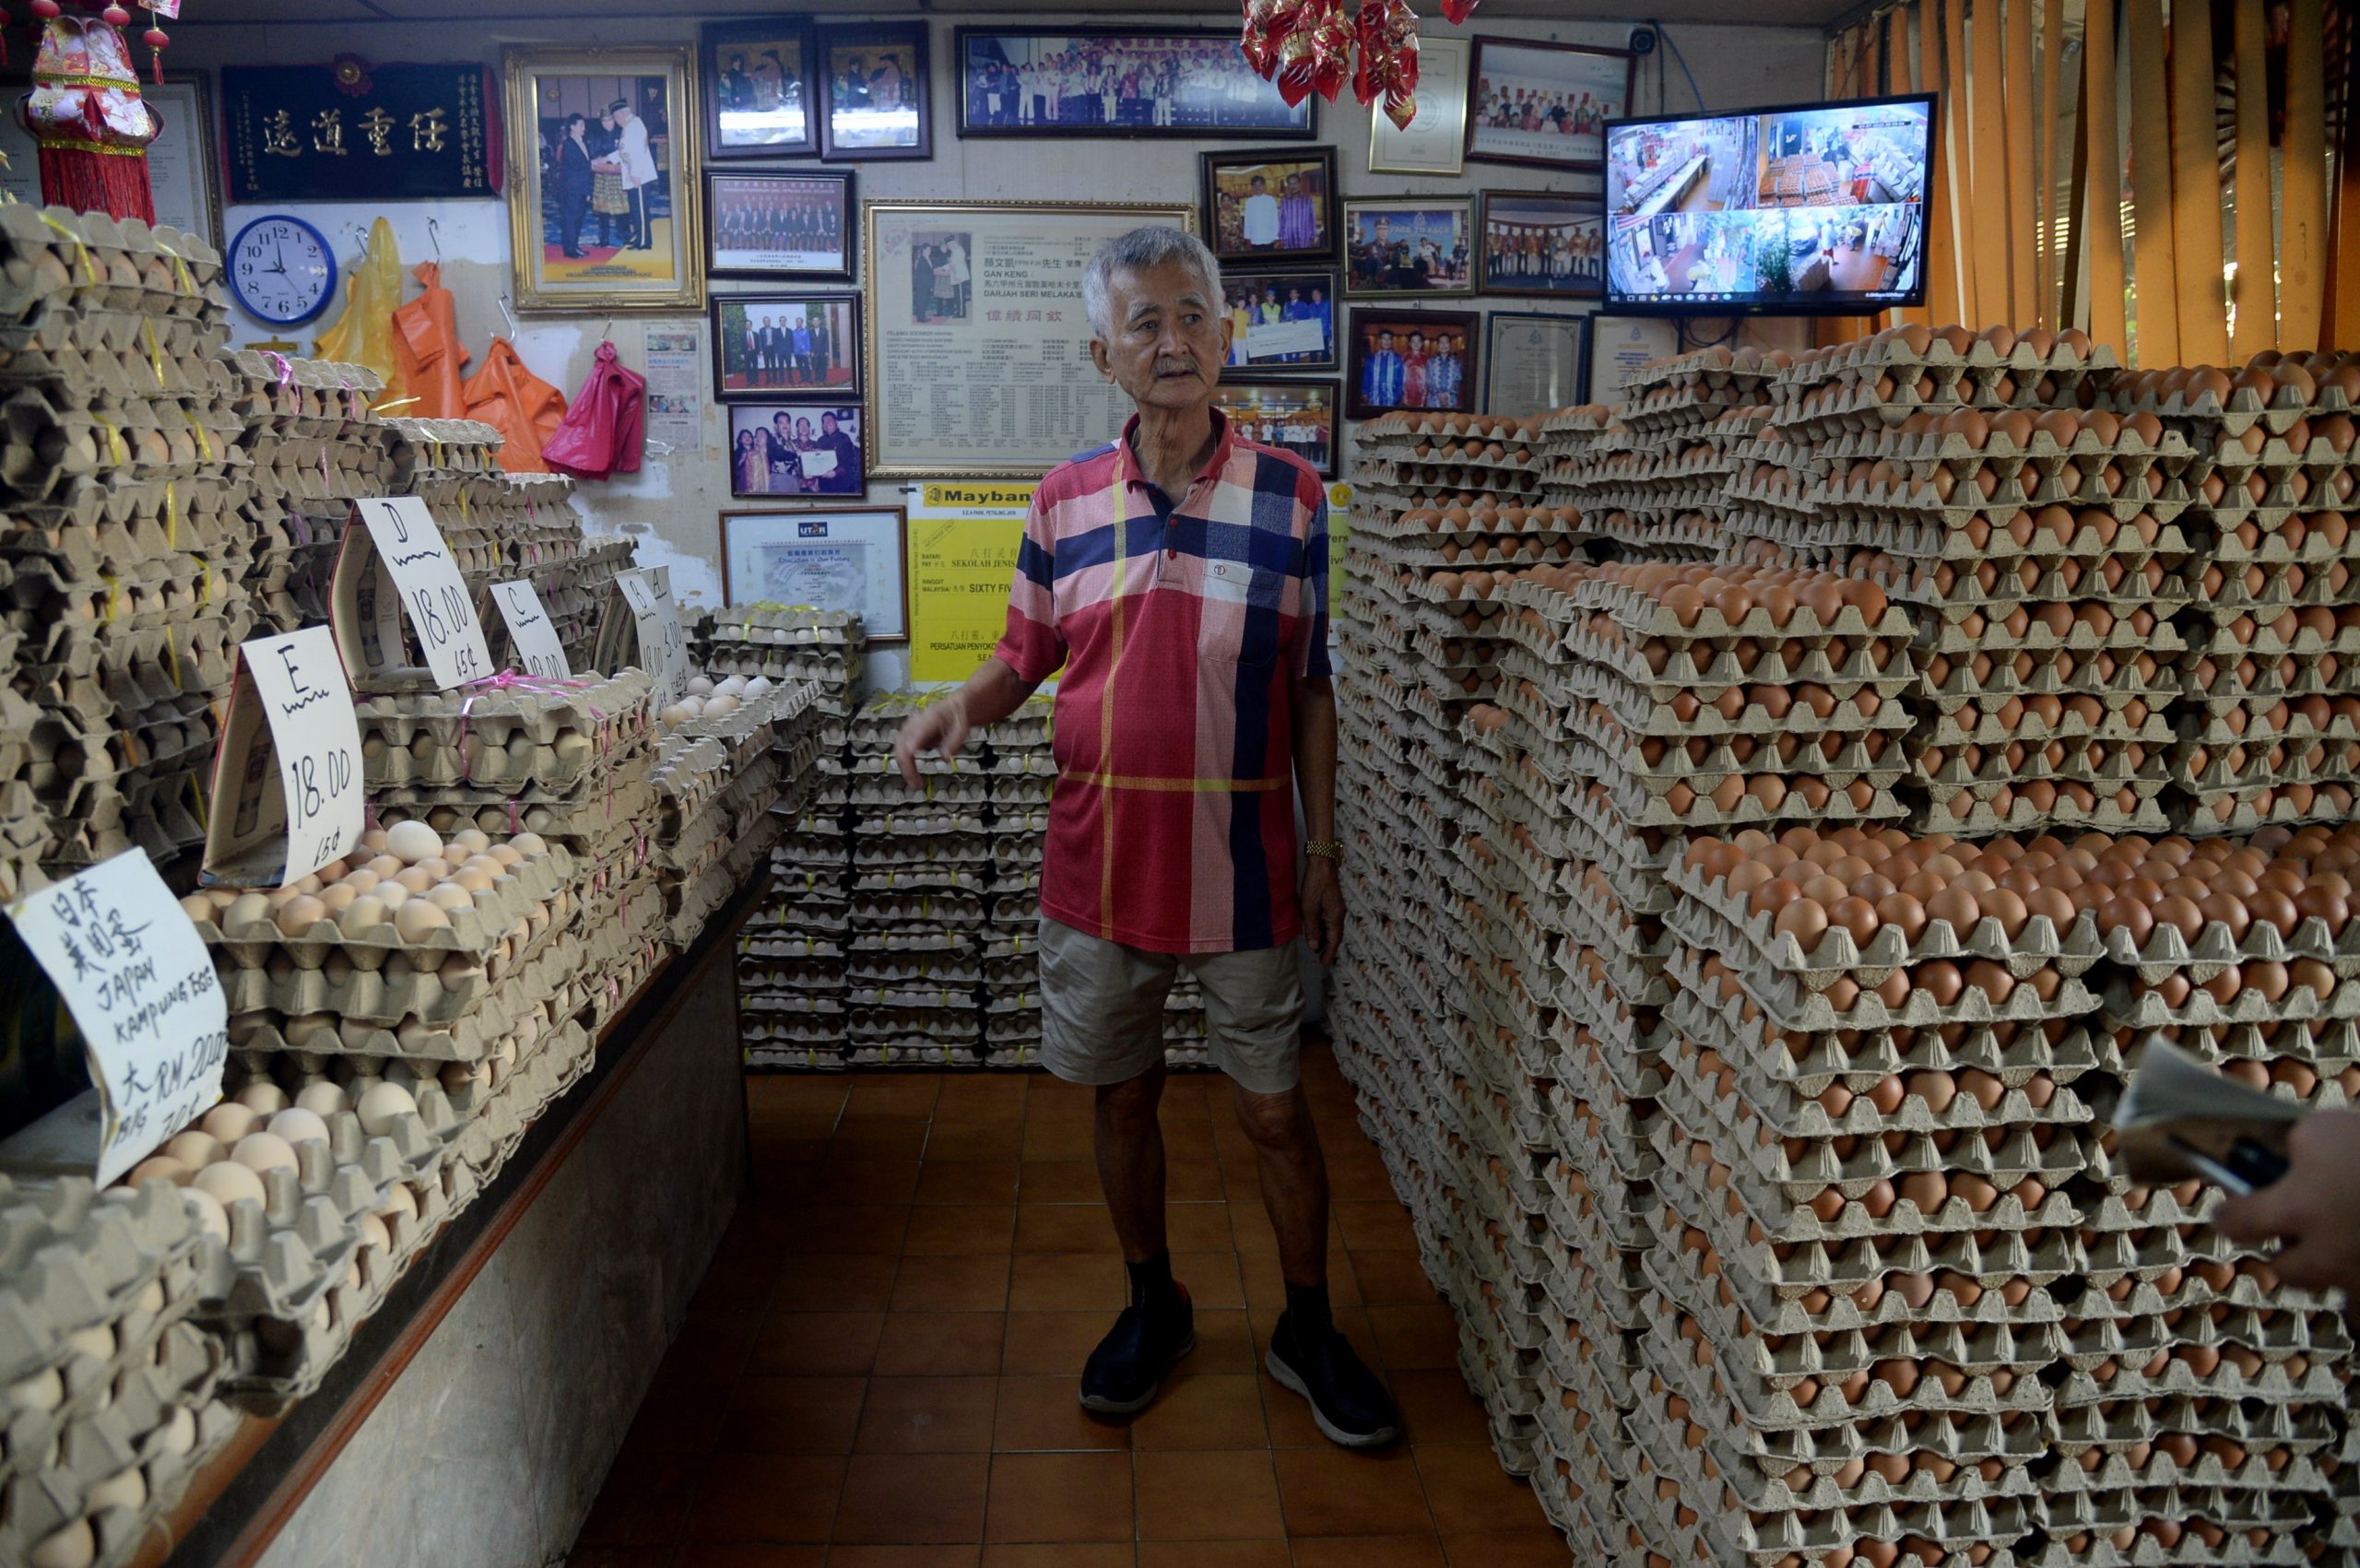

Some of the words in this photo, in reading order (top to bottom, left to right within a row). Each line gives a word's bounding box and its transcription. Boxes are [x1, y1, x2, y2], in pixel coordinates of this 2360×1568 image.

[259, 233, 270, 245] 11
[273, 227, 289, 239] 12
[296, 232, 301, 243] 1
[247, 246, 262, 258] 10
[307, 245, 317, 258] 2
[242, 263, 253, 276] 9
[1042, 258, 1062, 269] 先生
[984, 270, 1002, 278] GAN
[1004, 270, 1028, 278] KENG
[247, 281, 259, 294] 8
[308, 282, 319, 295] 4
[261, 296, 271, 309] 7
[278, 301, 289, 313] 6
[297, 296, 308, 309] 5
[944, 489, 1033, 504] Mayban
[382, 502, 408, 543] D
[951, 560, 991, 568] SEKOLAH
[993, 560, 1016, 568] JENIS
[653, 568, 661, 594] A
[969, 584, 996, 593] SIXTY
[998, 584, 1012, 593] FIV
[508, 586, 525, 615] C
[411, 584, 468, 651] 18.00
[929, 642, 966, 650] PERSATUAN
[277, 644, 310, 693] E
[291, 748, 351, 830] 18.00
[98, 956, 157, 1012] JAPAN
[114, 981, 189, 1043] KAMPUNG
